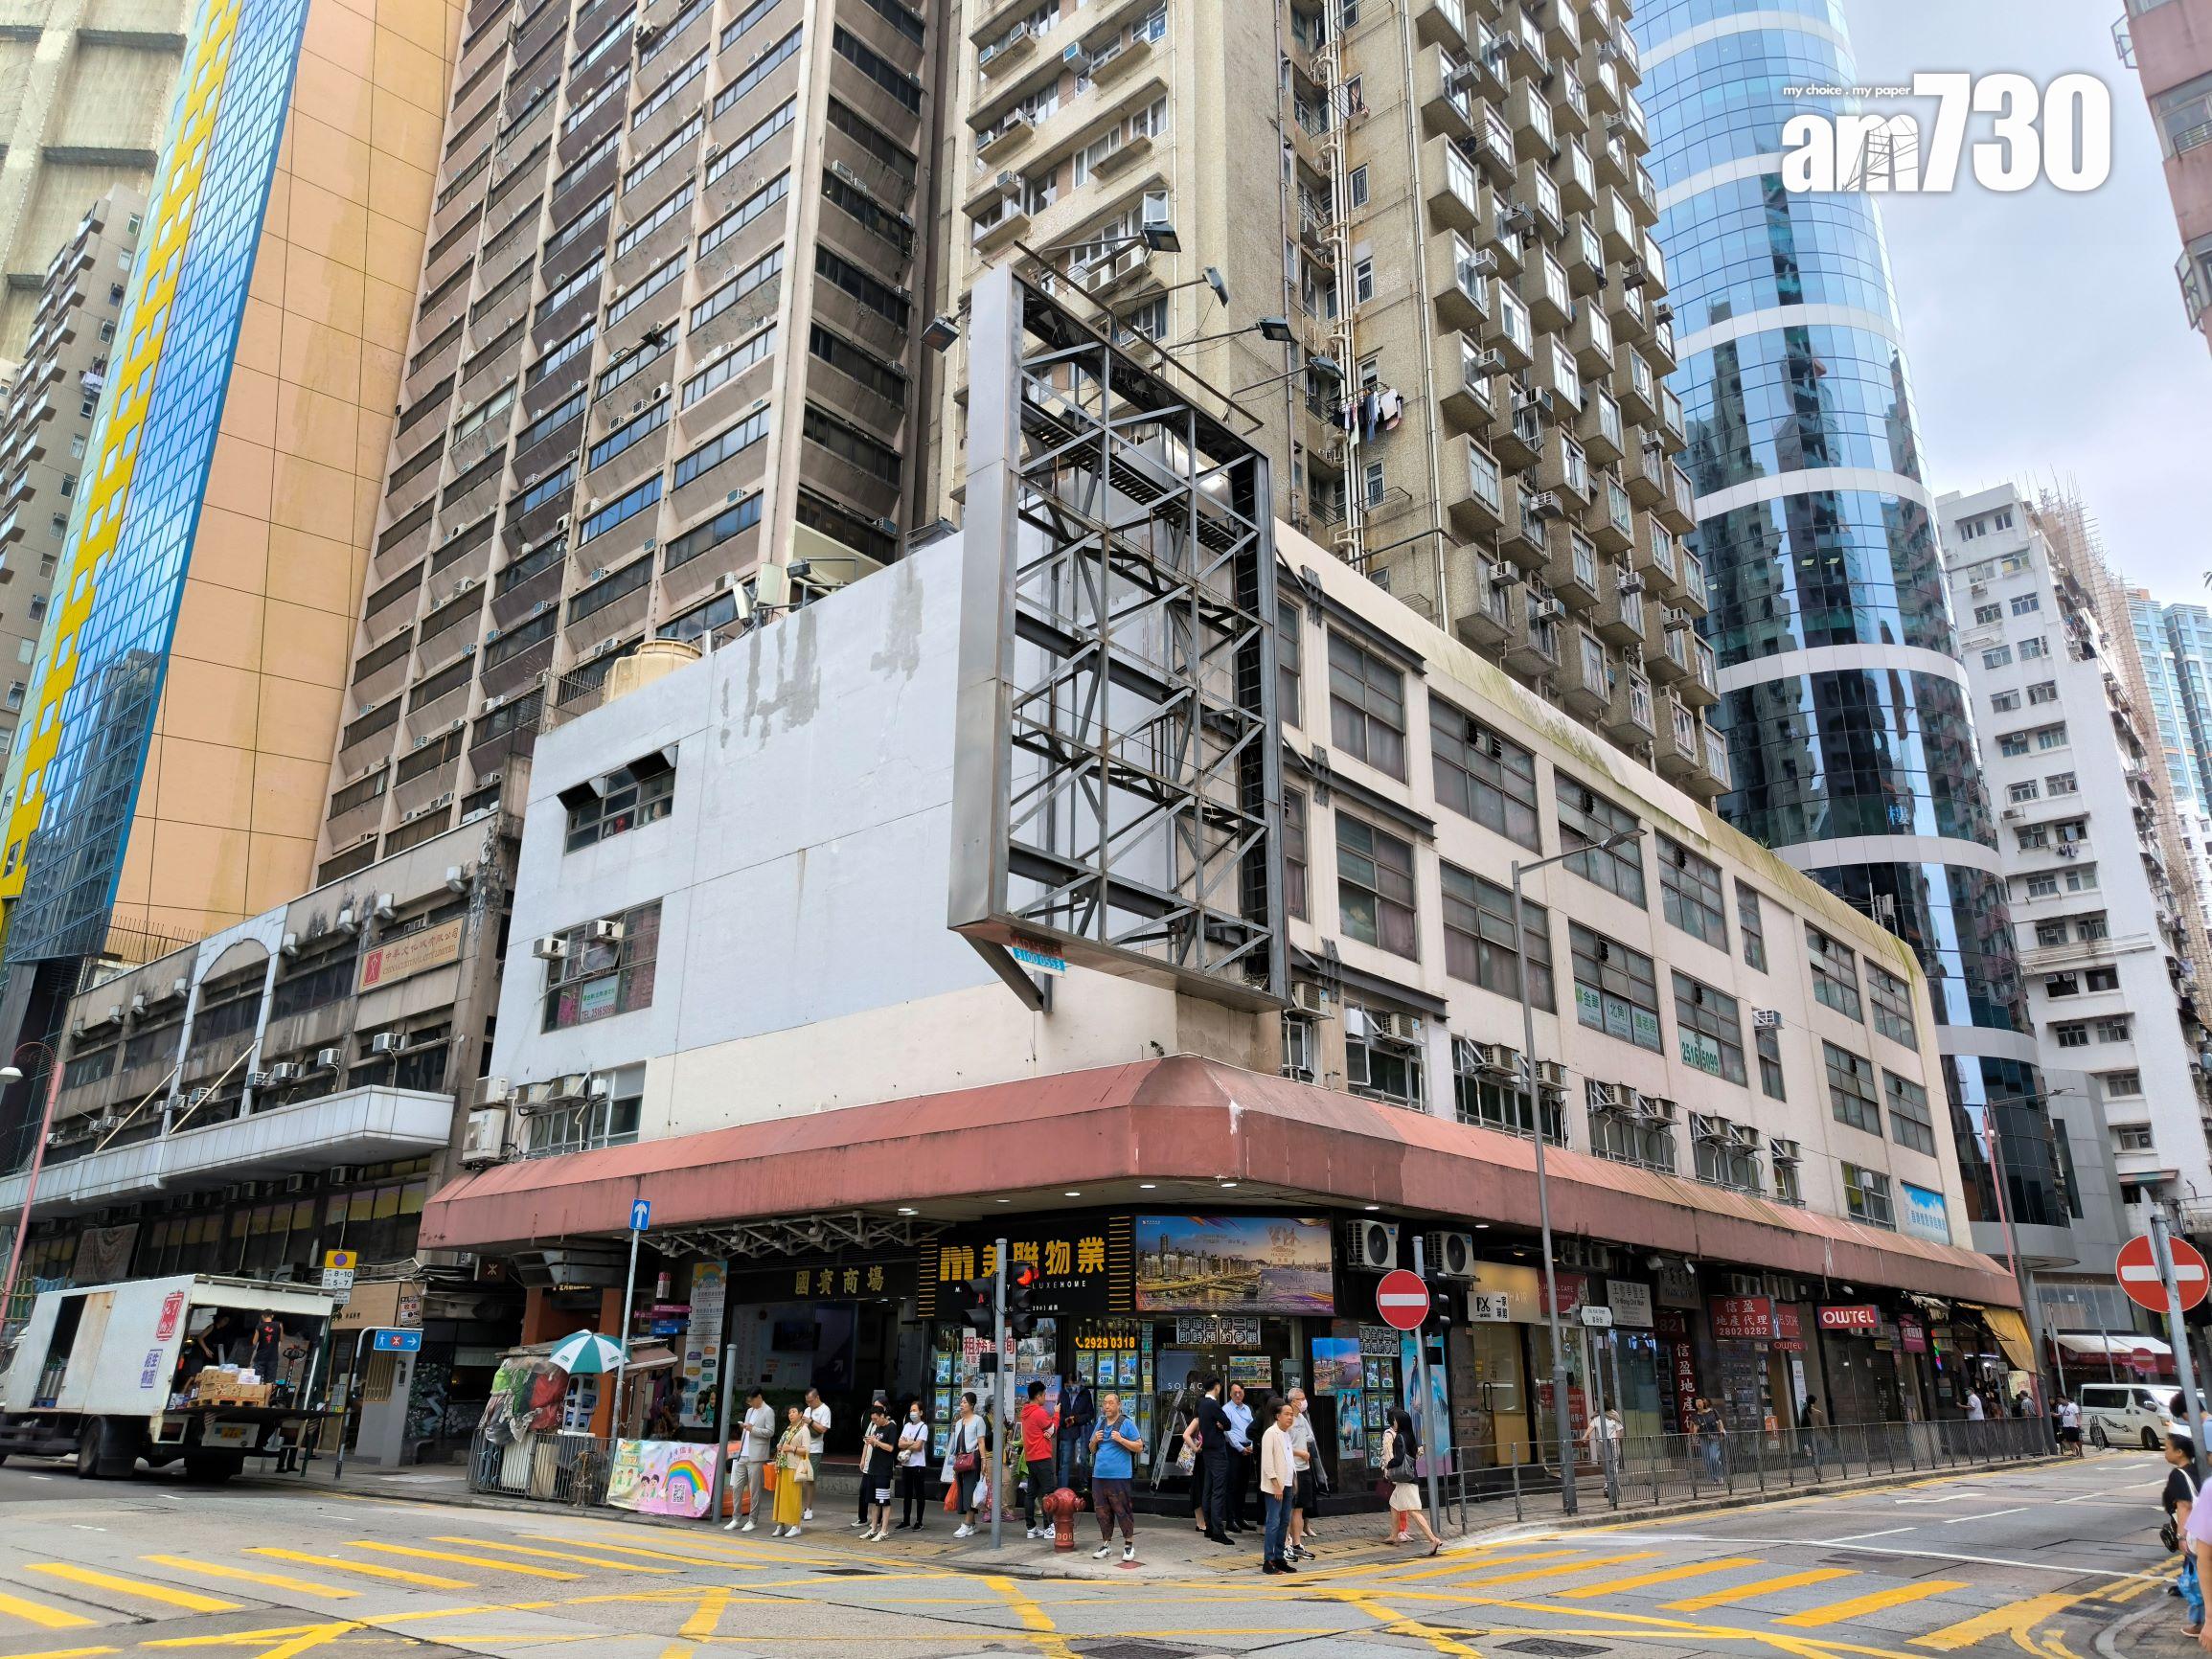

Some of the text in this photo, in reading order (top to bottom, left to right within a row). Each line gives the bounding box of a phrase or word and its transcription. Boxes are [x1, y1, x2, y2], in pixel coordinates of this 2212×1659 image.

[1681, 1041, 1720, 1074] 2516 5099
[1724, 1300, 1756, 1313] 信盈
[1716, 1315, 1768, 1327] 地產代理
[1822, 1310, 1875, 1324] OWTEL
[1719, 1327, 1767, 1336] 2802 0282
[1083, 1337, 1135, 1349] 2929 0318
